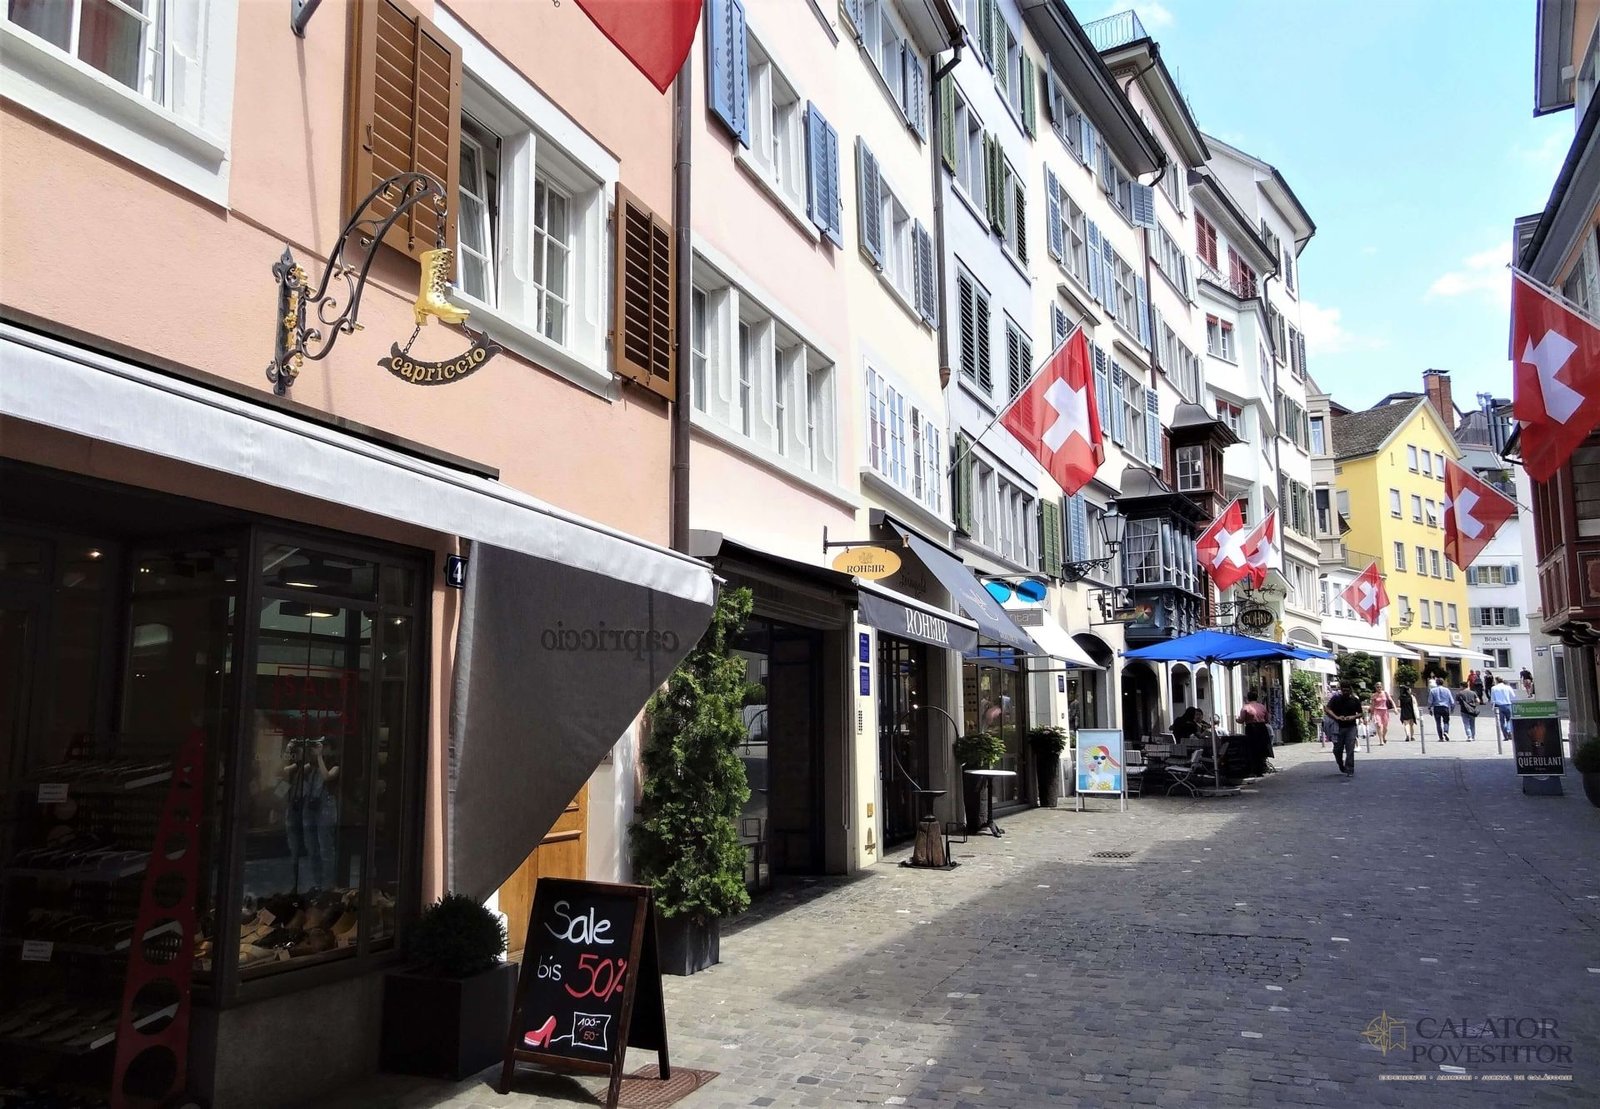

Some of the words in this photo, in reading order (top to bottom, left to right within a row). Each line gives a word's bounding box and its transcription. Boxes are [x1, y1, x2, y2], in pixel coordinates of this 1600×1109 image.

[391, 347, 486, 383] capriccio
[846, 564, 885, 574] ROHMIR
[905, 607, 949, 644] ROHMIR
[544, 900, 614, 945] Sale
[537, 955, 561, 981] bis
[564, 953, 627, 1002] 50%
